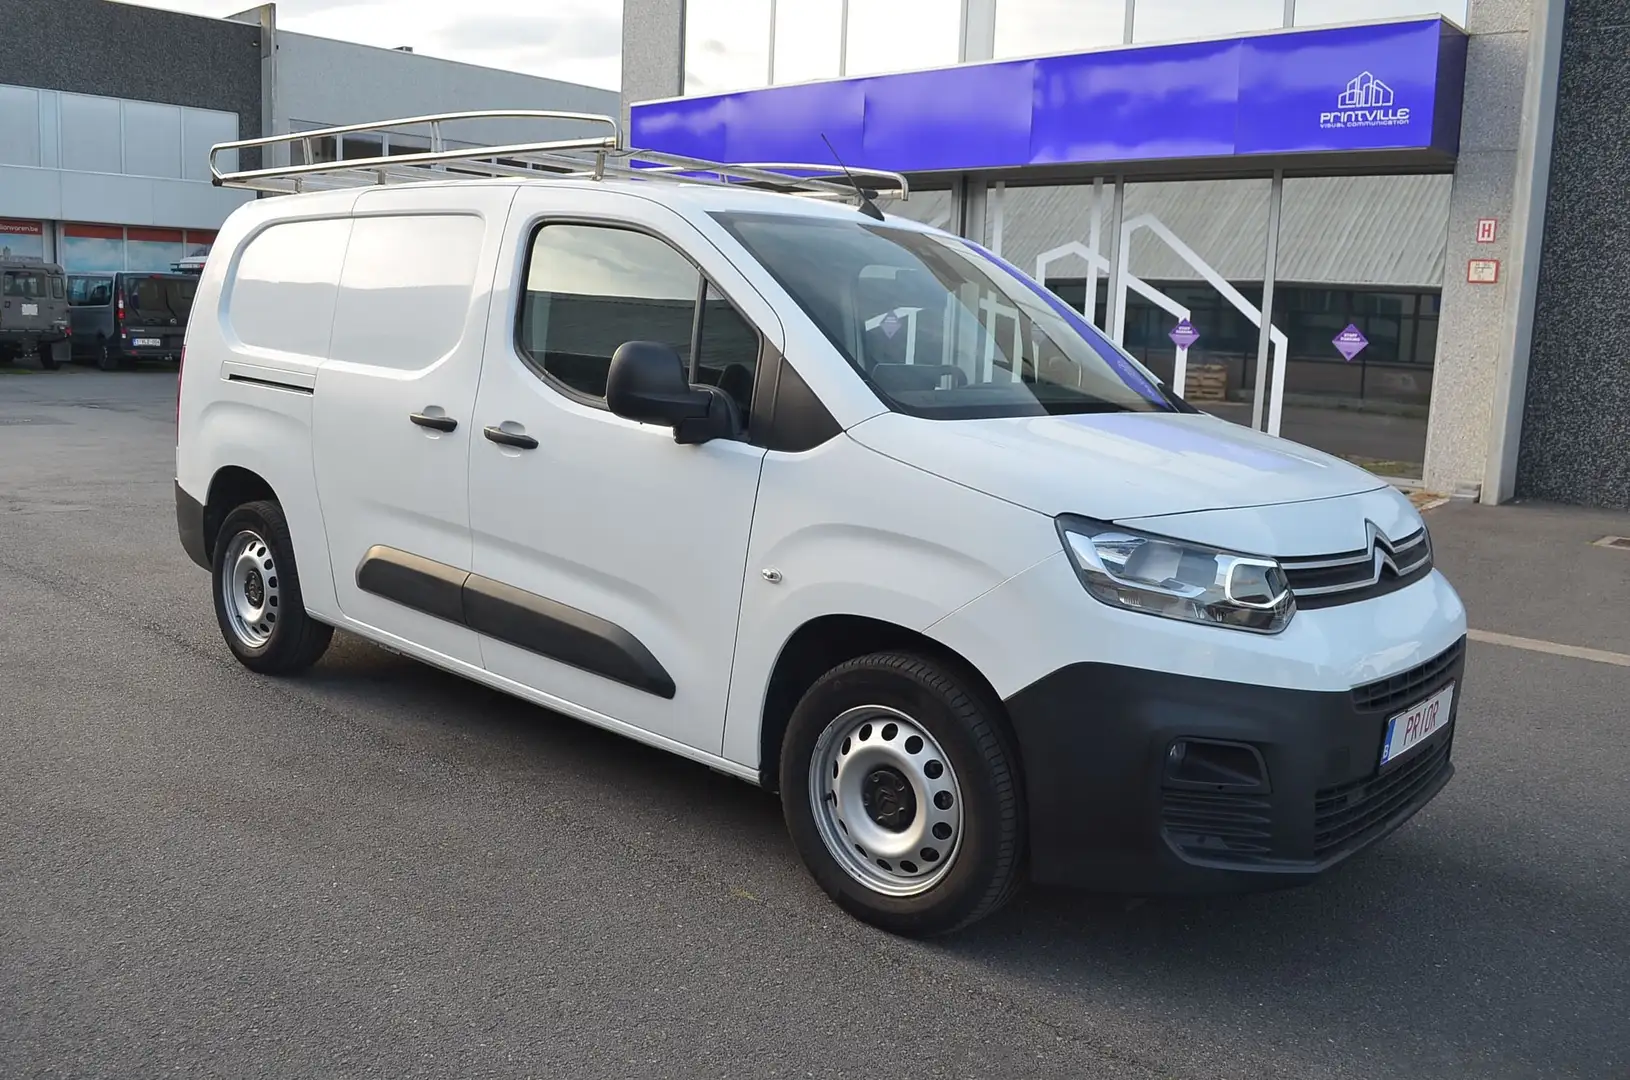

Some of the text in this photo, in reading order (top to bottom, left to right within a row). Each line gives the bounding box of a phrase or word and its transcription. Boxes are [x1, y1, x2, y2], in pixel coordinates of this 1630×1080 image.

[1320, 108, 1410, 123] PRINTVILLE
[1482, 223, 1492, 238] H
[1403, 700, 1439, 746] PRIOR
[1383, 744, 1389, 759] B
